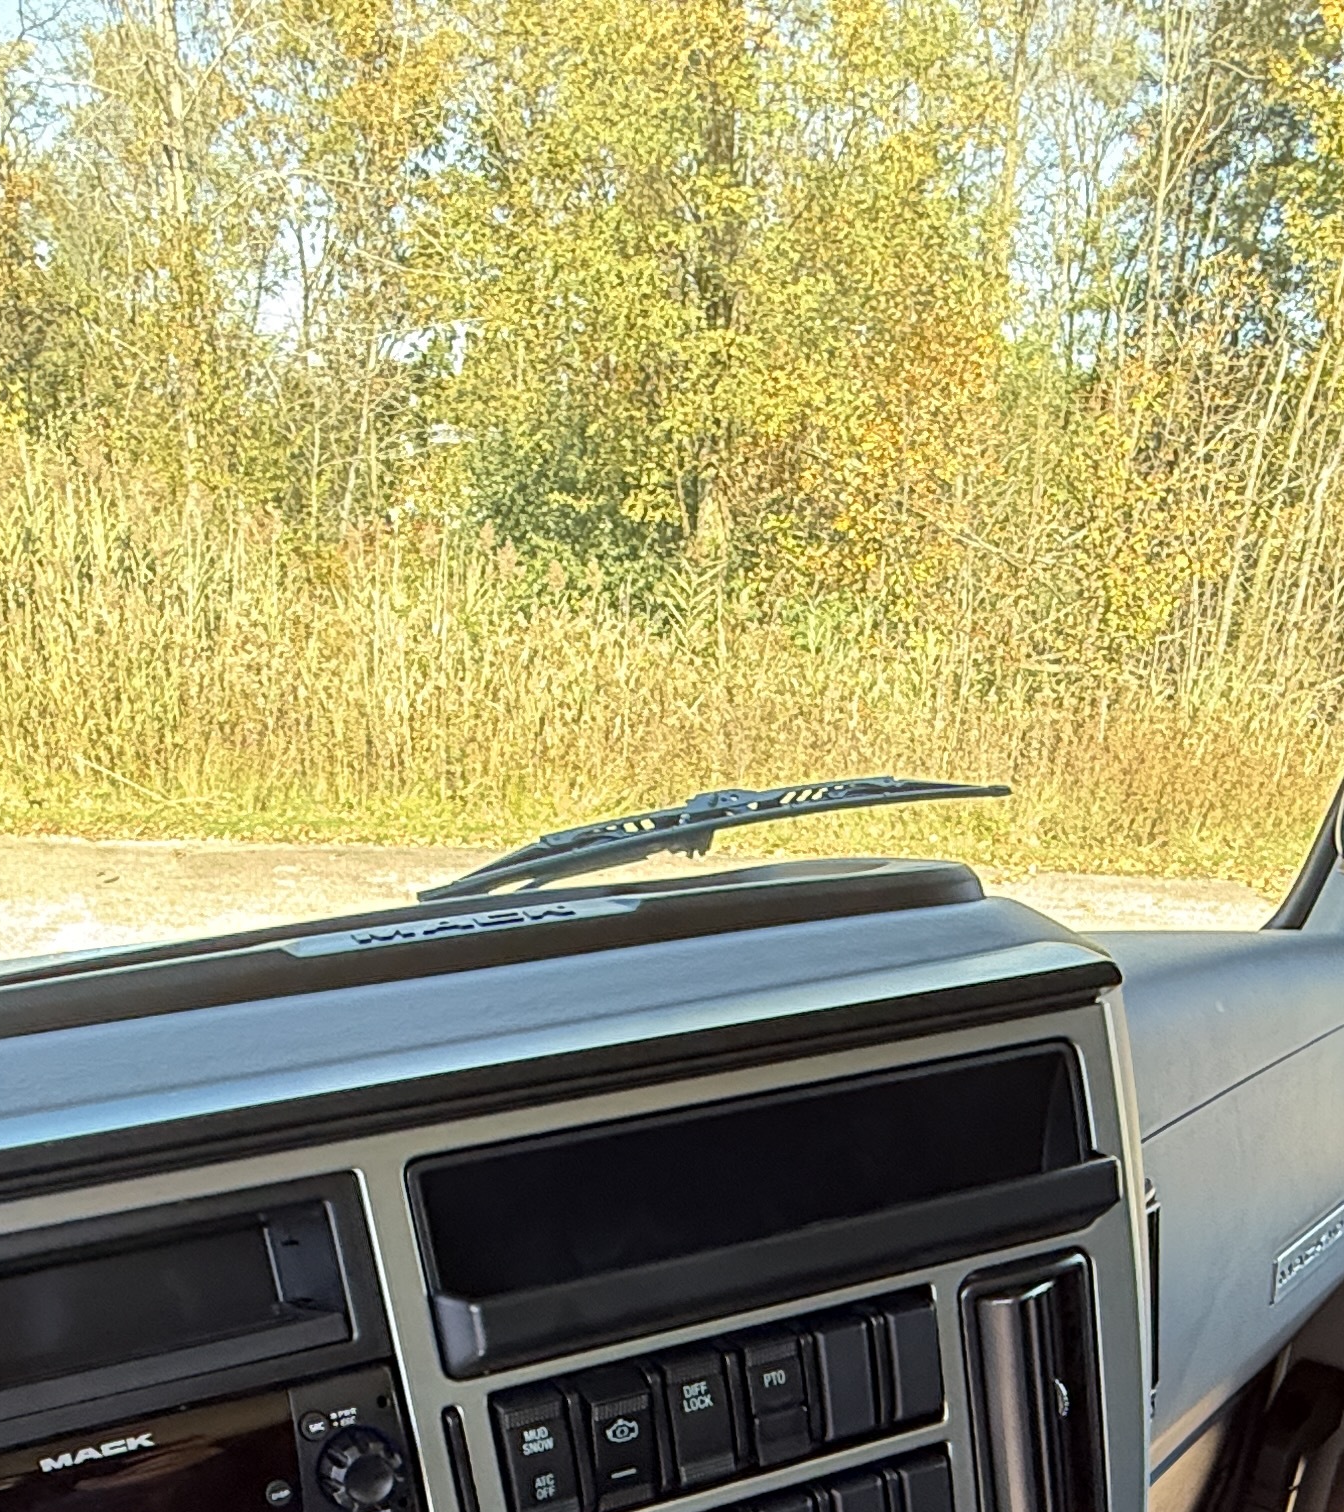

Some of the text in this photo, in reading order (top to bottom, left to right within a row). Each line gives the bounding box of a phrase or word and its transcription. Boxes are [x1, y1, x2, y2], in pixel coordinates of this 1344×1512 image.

[762, 1369, 787, 1388] PTO
[682, 1381, 708, 1398] DIFF
[682, 1394, 714, 1413] LOCK
[523, 1425, 549, 1442] MUD
[38, 1431, 156, 1473] MACK
[521, 1437, 554, 1456] SNOW
[534, 1473, 555, 1489] ATC
[536, 1486, 556, 1500] OFF
